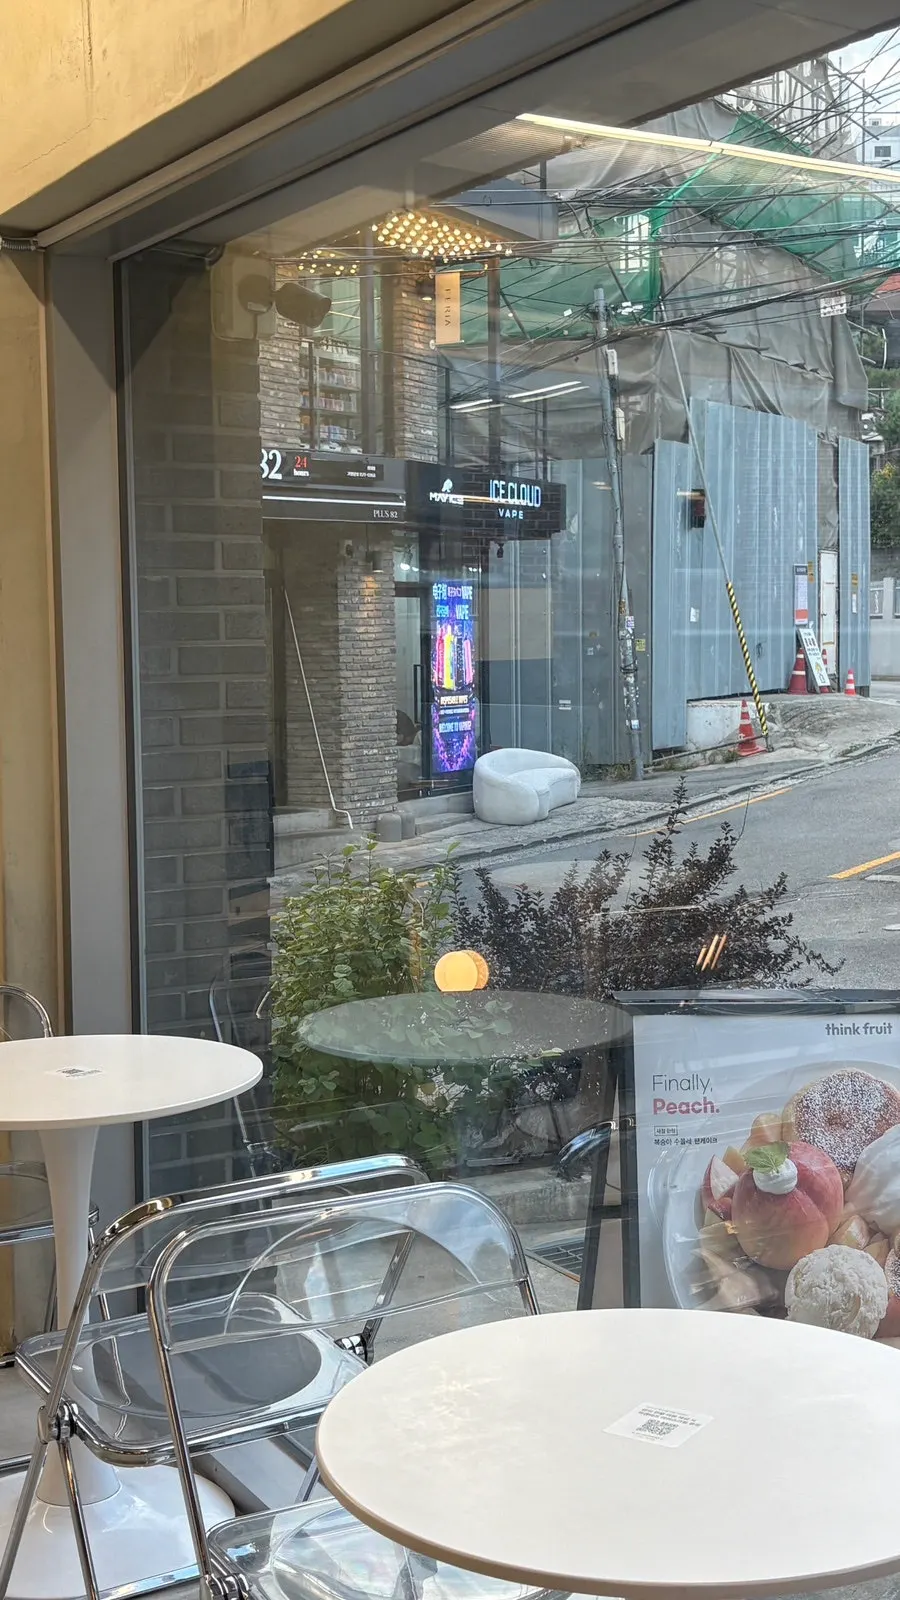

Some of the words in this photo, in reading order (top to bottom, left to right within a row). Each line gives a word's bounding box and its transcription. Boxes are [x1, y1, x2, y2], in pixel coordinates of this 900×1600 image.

[295, 455, 308, 468] 24
[489, 479, 506, 503] ICE
[507, 482, 542, 508] CLOUD
[373, 509, 389, 518] PLUS
[389, 510, 398, 519] 82
[498, 508, 524, 520] VAPE
[455, 604, 469, 620] VAPE
[825, 1022, 861, 1036] think
[863, 1022, 893, 1036] fruit
[652, 1073, 714, 1093] Finally,
[653, 1096, 720, 1115] Peach.
